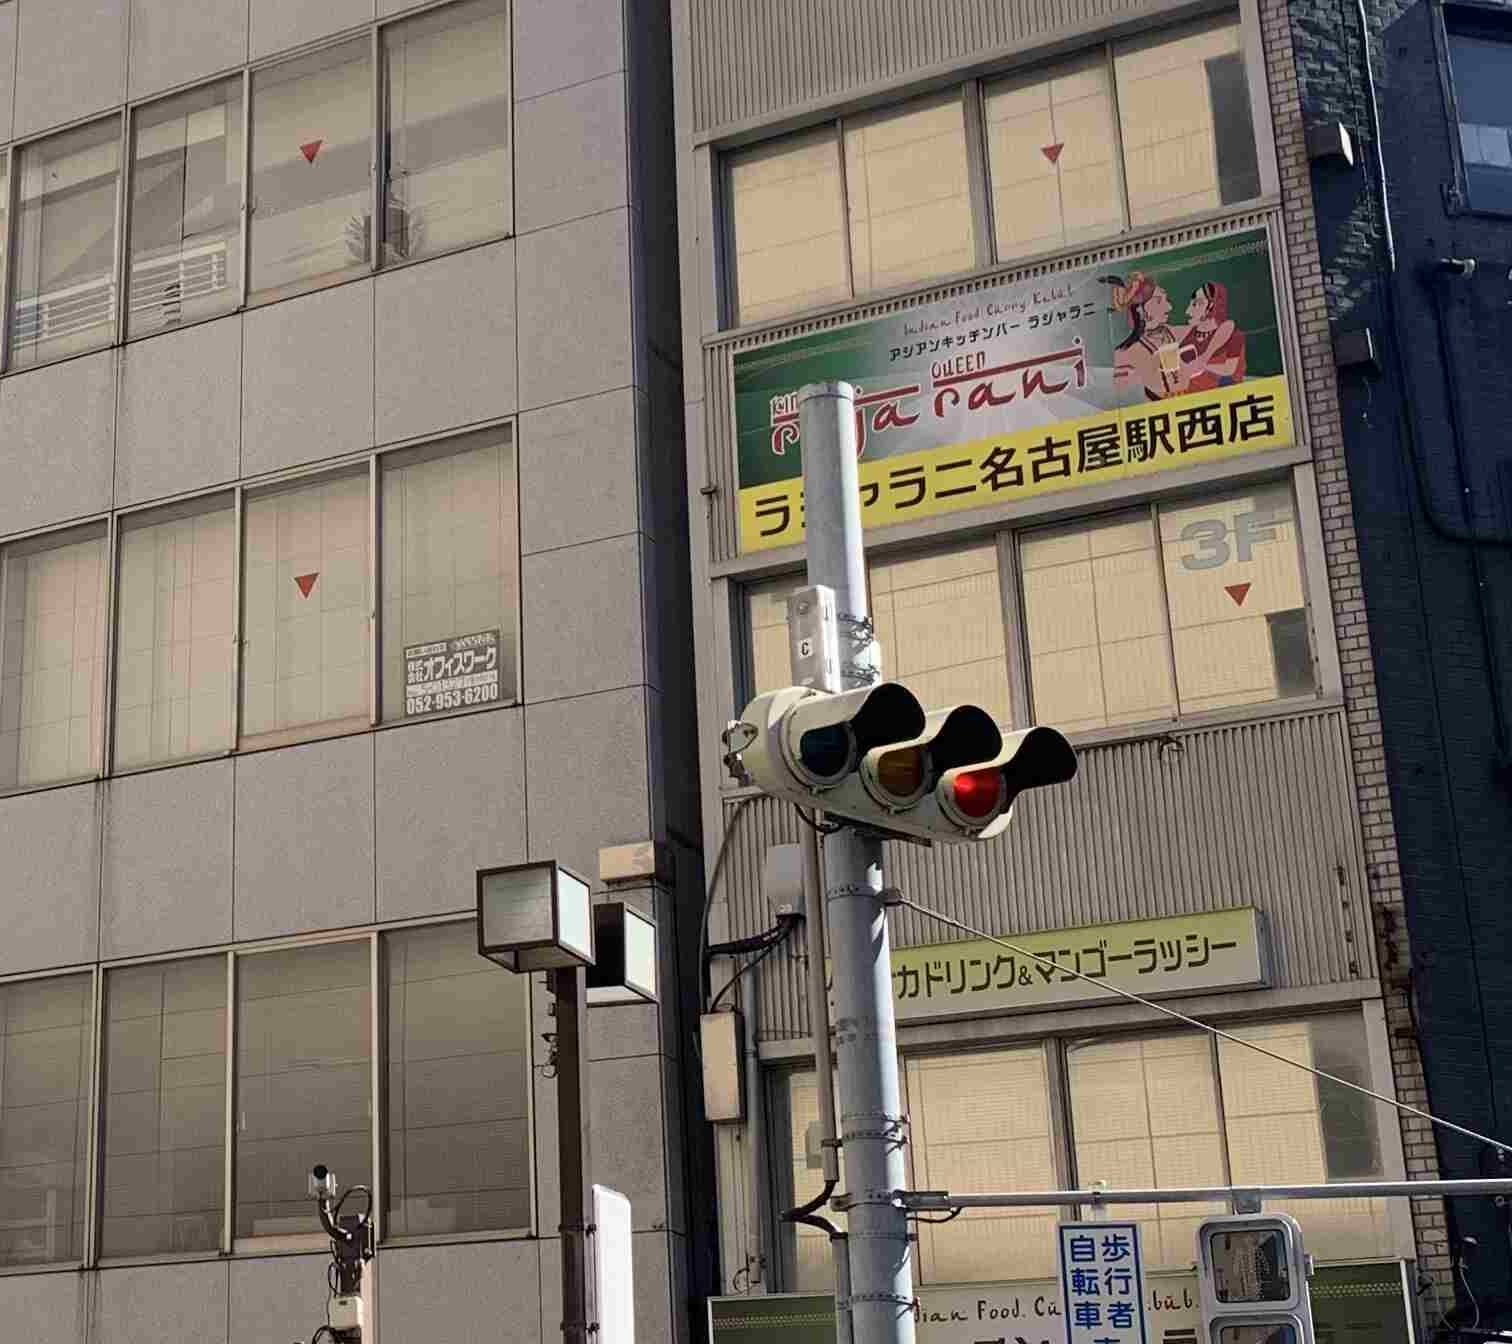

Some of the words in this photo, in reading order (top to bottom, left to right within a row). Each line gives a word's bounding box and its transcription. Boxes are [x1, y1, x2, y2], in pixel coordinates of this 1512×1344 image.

[889, 322, 1020, 362] アジアンキッチンバー
[1028, 302, 1097, 329] ラジャラニ
[755, 393, 1275, 537] ララニ名古屋駅西店
[1180, 509, 1275, 572] 3F
[892, 935, 1237, 999] カドリンク&マンゴーラッシー
[1070, 1235, 1103, 1330] 自転車
[1101, 1233, 1135, 1329] 歩行者
